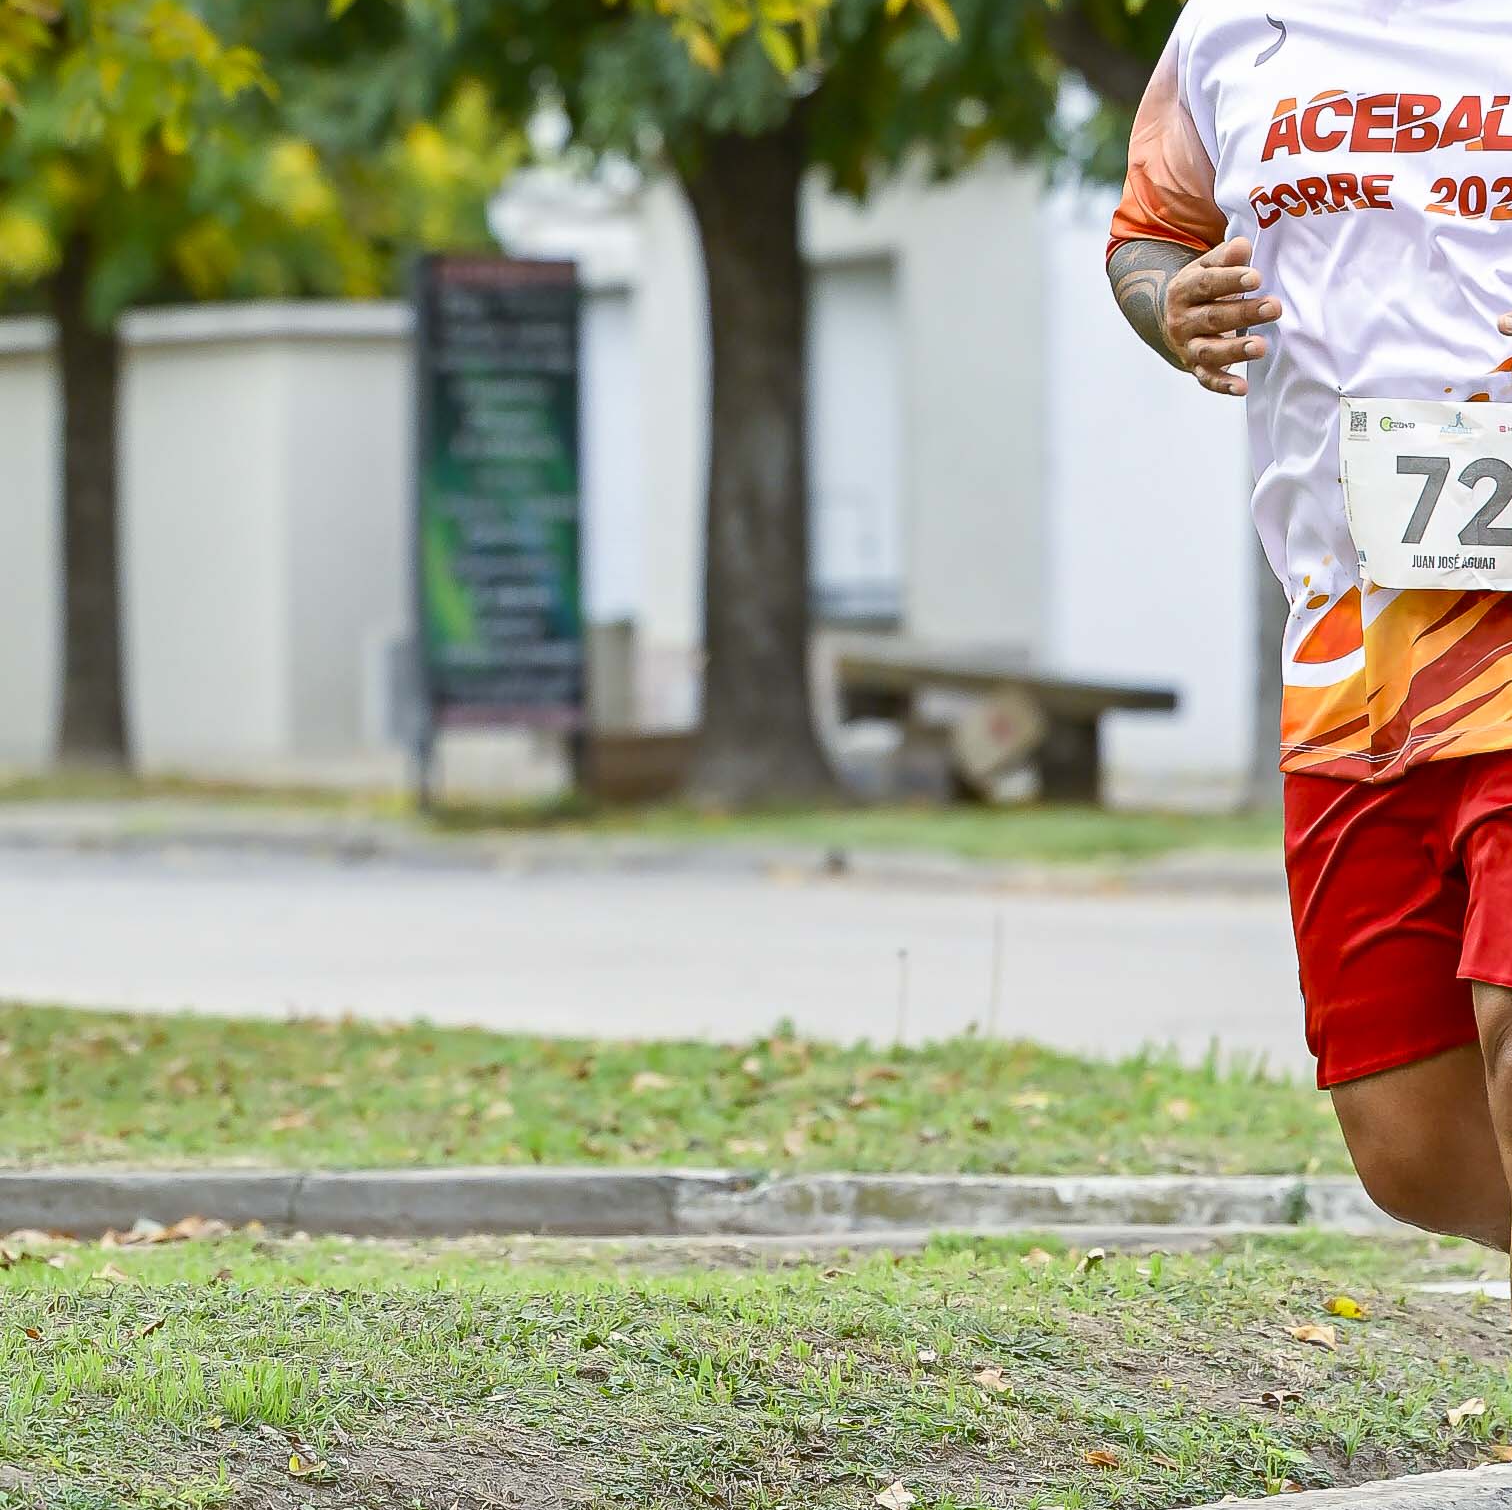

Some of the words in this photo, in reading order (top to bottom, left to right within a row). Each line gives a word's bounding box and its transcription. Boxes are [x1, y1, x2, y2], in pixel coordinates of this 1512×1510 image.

[1250, 173, 1394, 229] CORRE
[1412, 555, 1435, 568] JUAN
[1438, 554, 1460, 569] JOSÉ
[1461, 556, 1496, 570] AGUIAR
